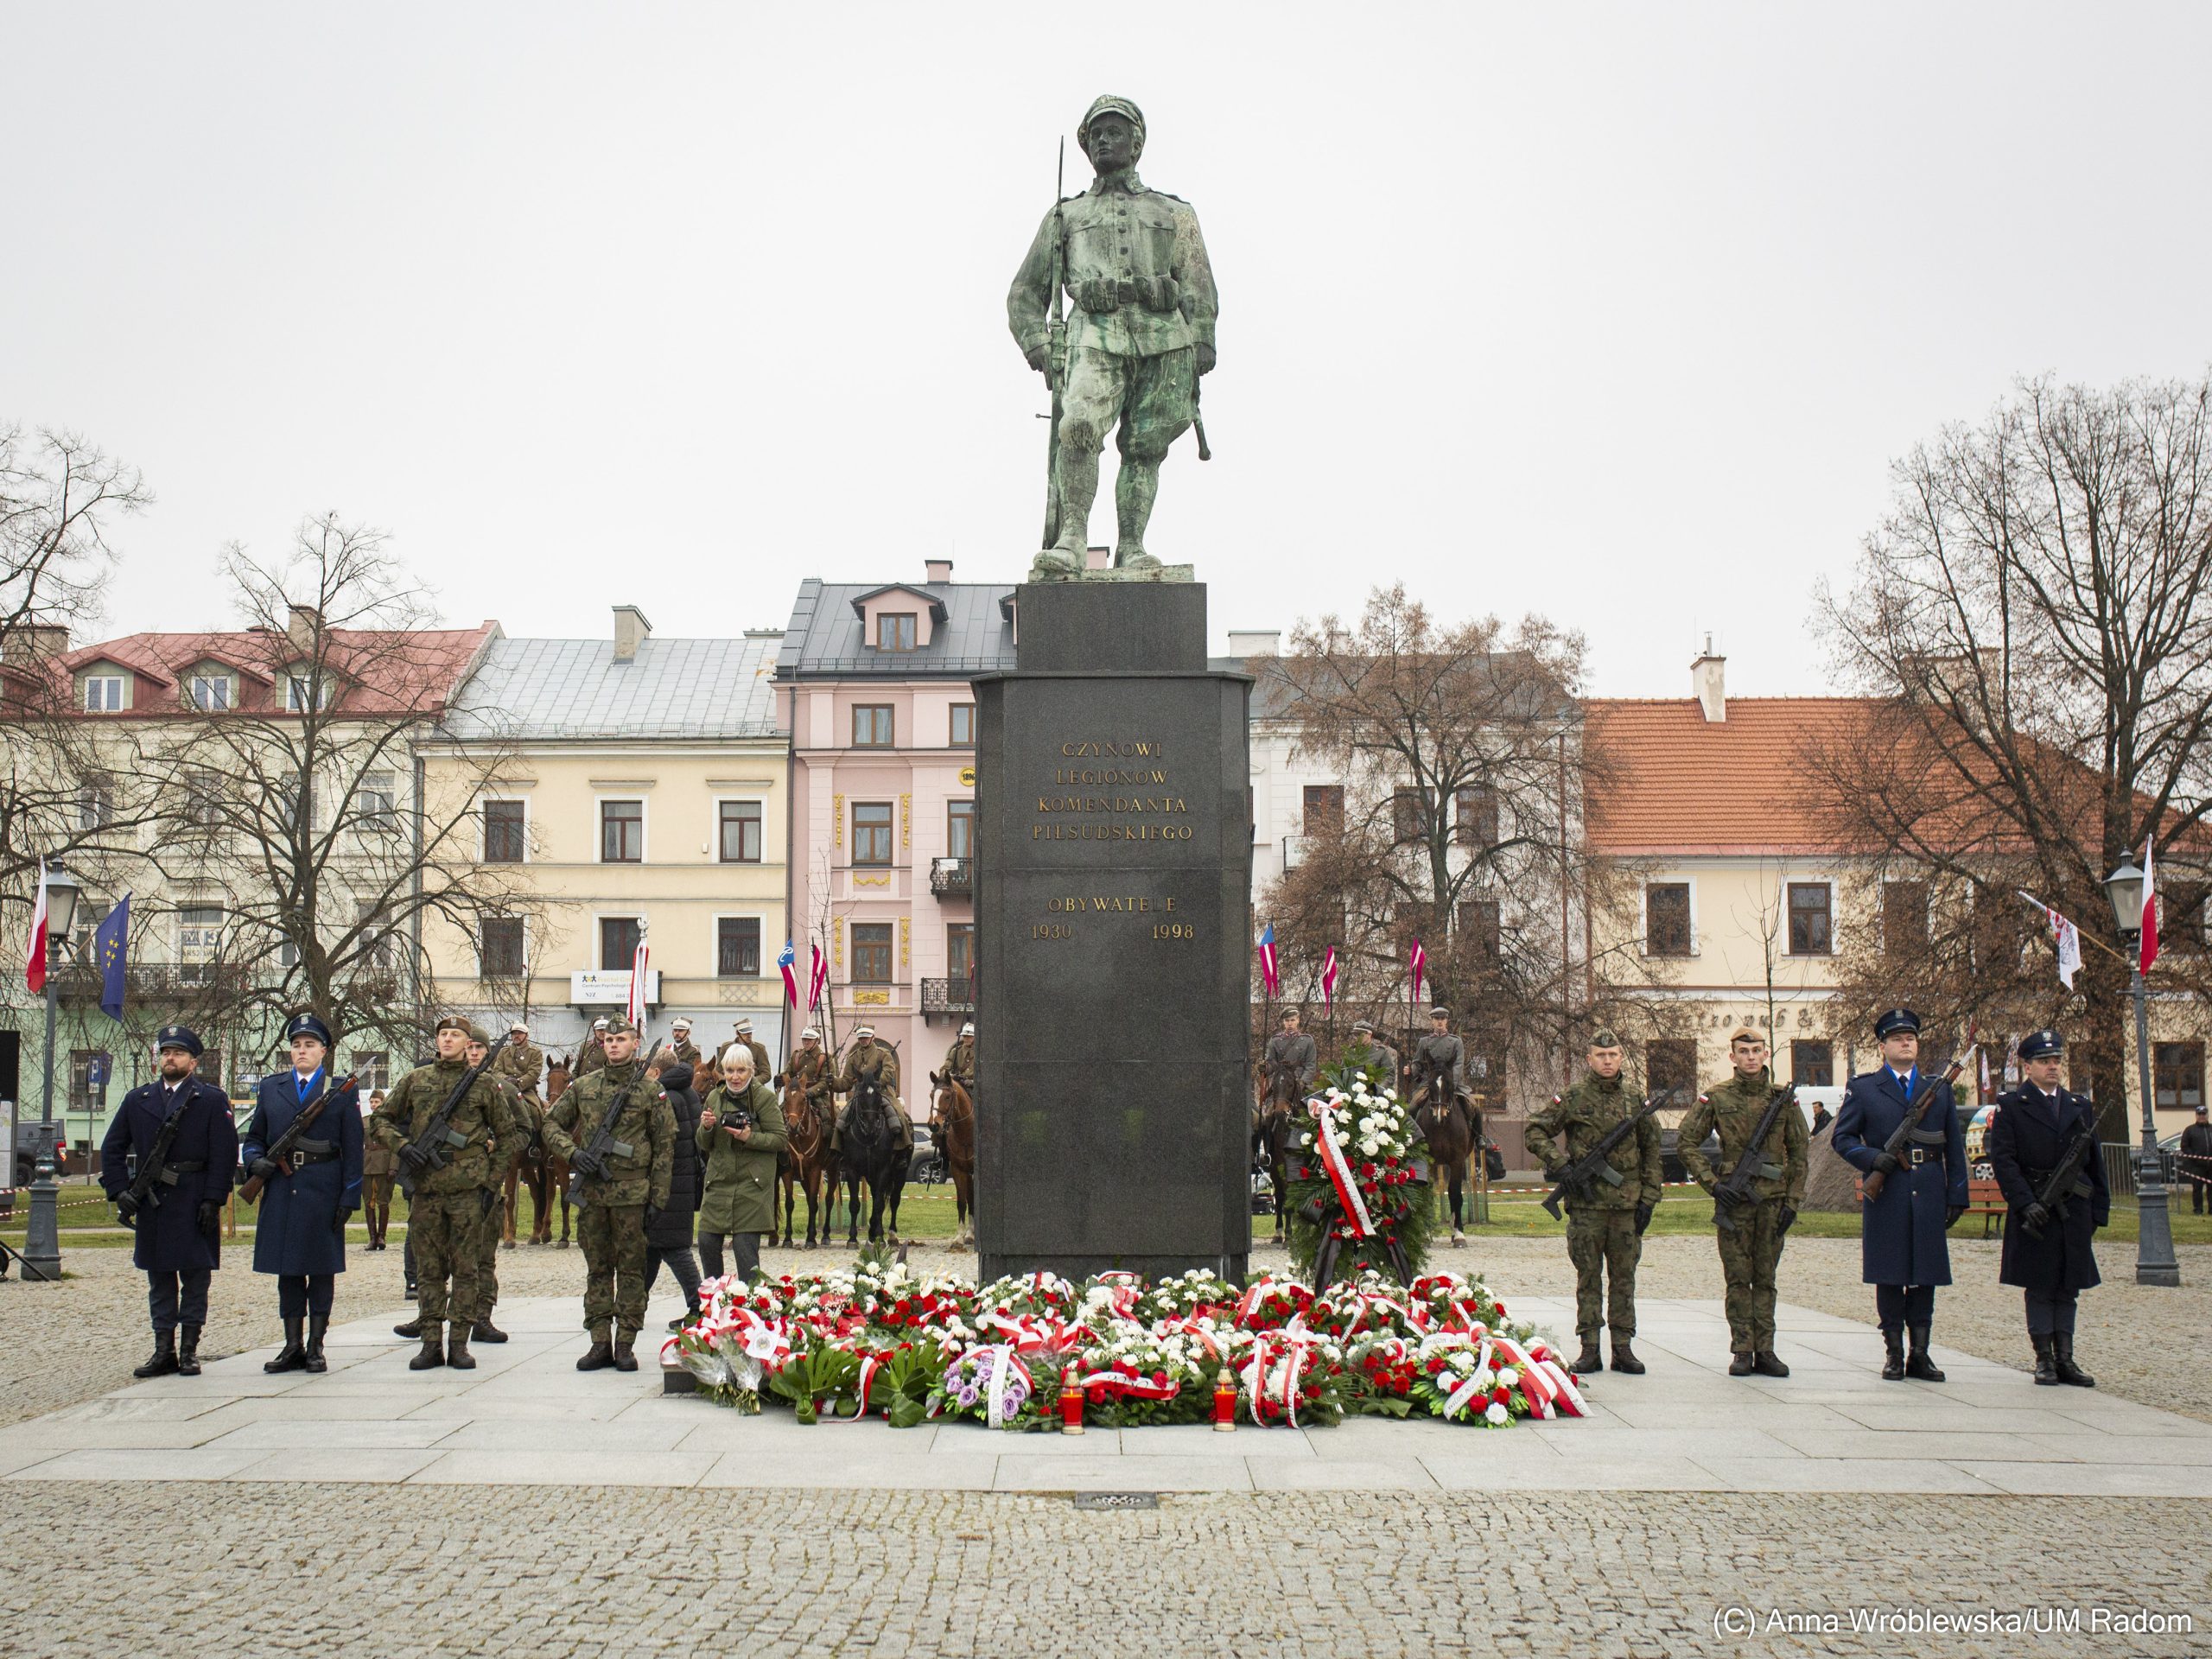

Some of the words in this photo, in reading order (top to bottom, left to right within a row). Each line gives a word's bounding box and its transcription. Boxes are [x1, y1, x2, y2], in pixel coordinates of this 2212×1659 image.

[1062, 742, 1162, 758] CZYNOWI
[1037, 798, 1188, 812] KOMENDANTA
[1048, 897, 1177, 912] OBYWATELE
[1032, 924, 1072, 939] 1930
[1152, 924, 1195, 939] 1998
